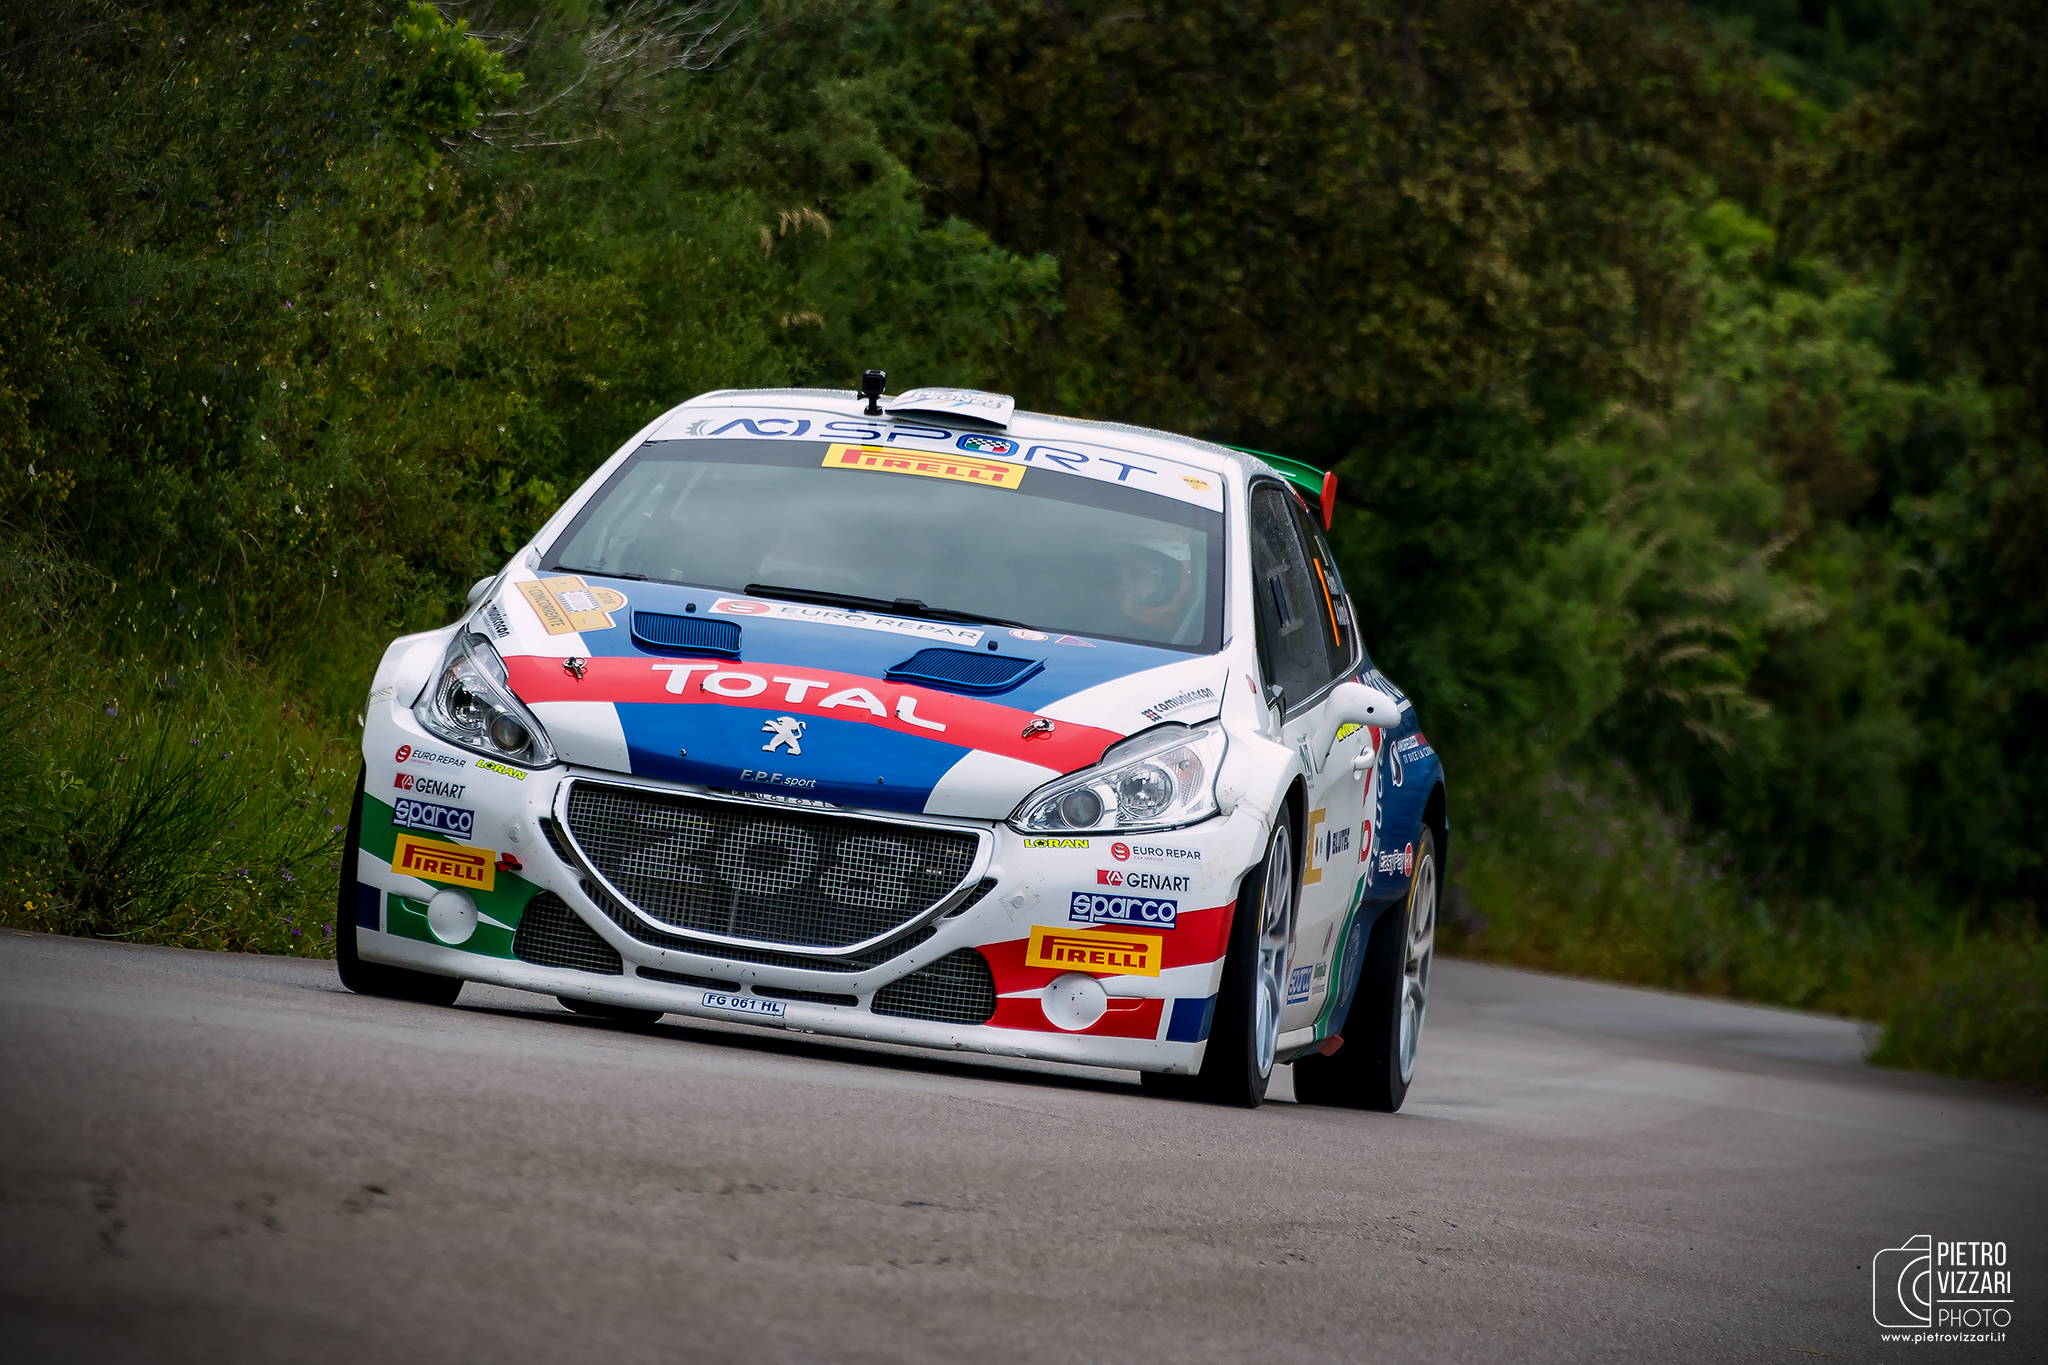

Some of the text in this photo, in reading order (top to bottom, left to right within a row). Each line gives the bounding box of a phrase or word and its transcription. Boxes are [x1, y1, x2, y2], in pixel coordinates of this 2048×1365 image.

[819, 421, 1157, 481] SPORT
[841, 449, 1009, 482] PIRELLI
[781, 607, 977, 639] EURO REPAR
[652, 664, 946, 732] TOTAL
[412, 750, 466, 767] EURO REPAR
[475, 759, 528, 780] LORAN
[416, 778, 466, 799] GENART
[395, 800, 472, 831] sparco
[1024, 839, 1089, 849] LORAN
[1133, 846, 1202, 860] EURO REPAR
[402, 844, 485, 882] PIRELLI
[1127, 872, 1190, 892] GENART
[1073, 894, 1176, 922] sparco
[1040, 935, 1148, 968] PIRELLI
[707, 994, 780, 1012] FG 061 HL
